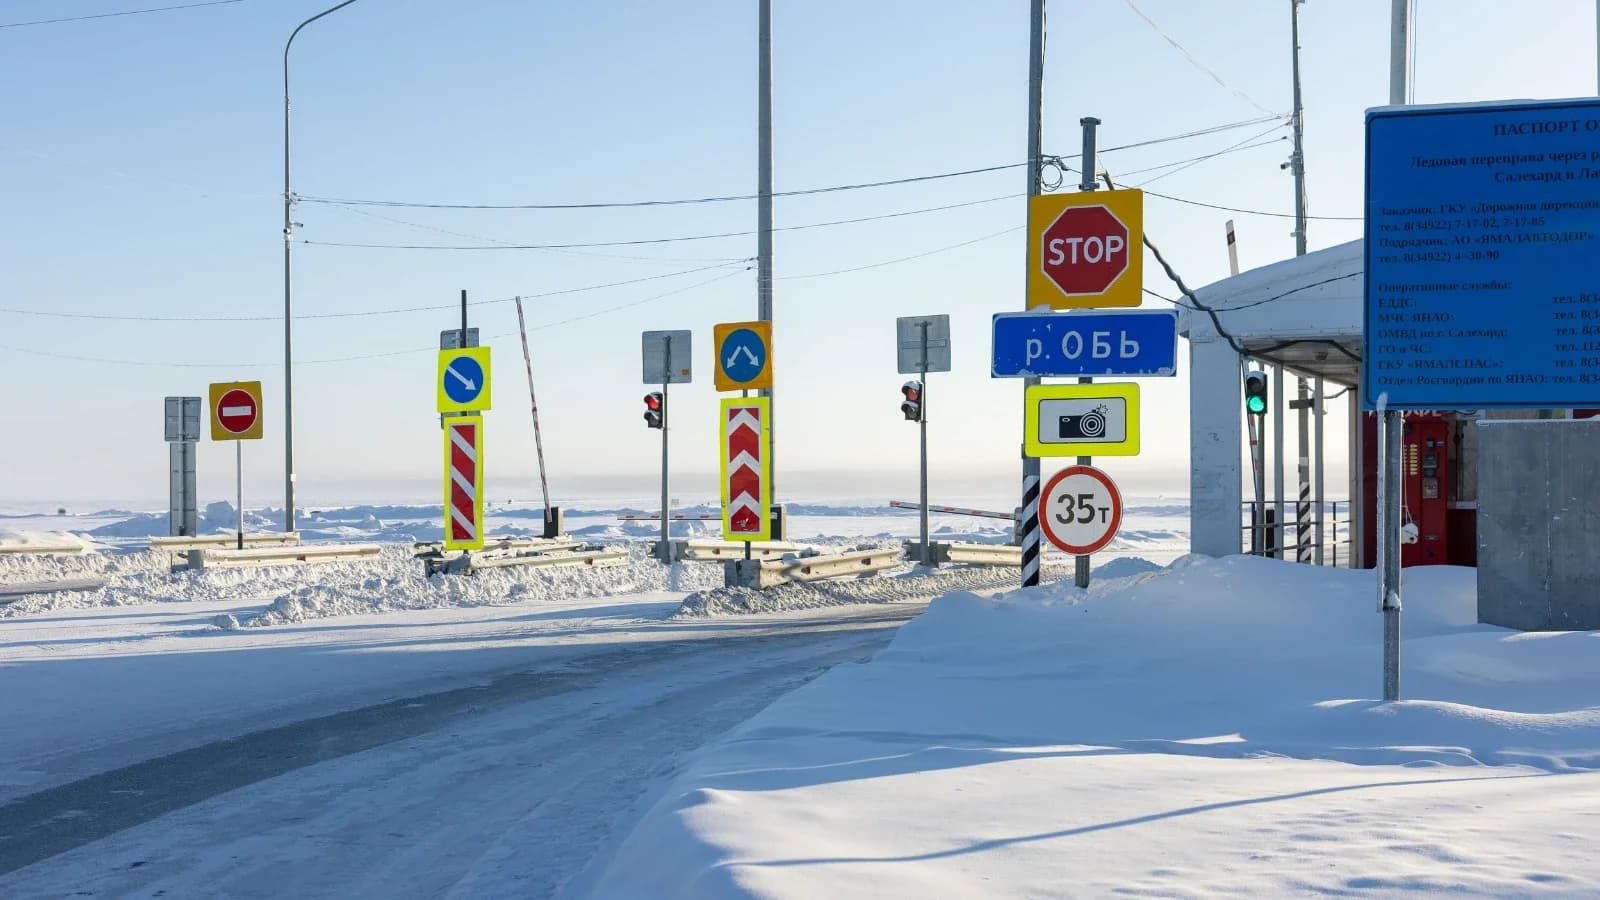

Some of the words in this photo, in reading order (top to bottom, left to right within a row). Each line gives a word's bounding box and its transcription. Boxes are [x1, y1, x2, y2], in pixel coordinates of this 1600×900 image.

[1494, 120, 1579, 136] ПАСПОРТ
[1585, 119, 1600, 131] О
[1411, 156, 1467, 169] Ледовая
[1471, 154, 1544, 167] переправа
[1549, 152, 1586, 164] через
[1495, 171, 1562, 183] Салехард
[1565, 171, 1574, 179] и
[1580, 168, 1600, 178] Ла
[1440, 204, 1465, 214] ГКУ
[1380, 224, 1399, 232] тел.
[1404, 220, 1452, 231] 8(34922)
[1379, 238, 1448, 249] Подрядчик:
[1454, 236, 1470, 245] АО
[1047, 235, 1124, 266] STOP
[1379, 255, 1400, 263] тел.
[1404, 252, 1451, 263] 8(34922)
[1379, 282, 1459, 293] Оперативные
[1462, 280, 1512, 291] службы:
[1379, 299, 1417, 309] ЕДДС:
[1553, 296, 1575, 304] тел.
[1379, 313, 1408, 323] МЧС
[1412, 312, 1455, 322] ЯНАО:
[1553, 312, 1577, 320] тел.
[1379, 328, 1416, 339] ОМВД
[1556, 328, 1577, 336] тел.
[1026, 338, 1050, 365] р.
[1061, 331, 1140, 359] ОБЬ
[1379, 345, 1396, 354] ГО
[1554, 343, 1578, 351] тел.
[1379, 360, 1402, 369] ГКУ
[1554, 359, 1577, 367] тел.
[1379, 376, 1413, 385] Отдел
[1506, 374, 1548, 384] ЯНАО:
[1553, 375, 1575, 383] тел.
[1055, 493, 1109, 525] 35т
